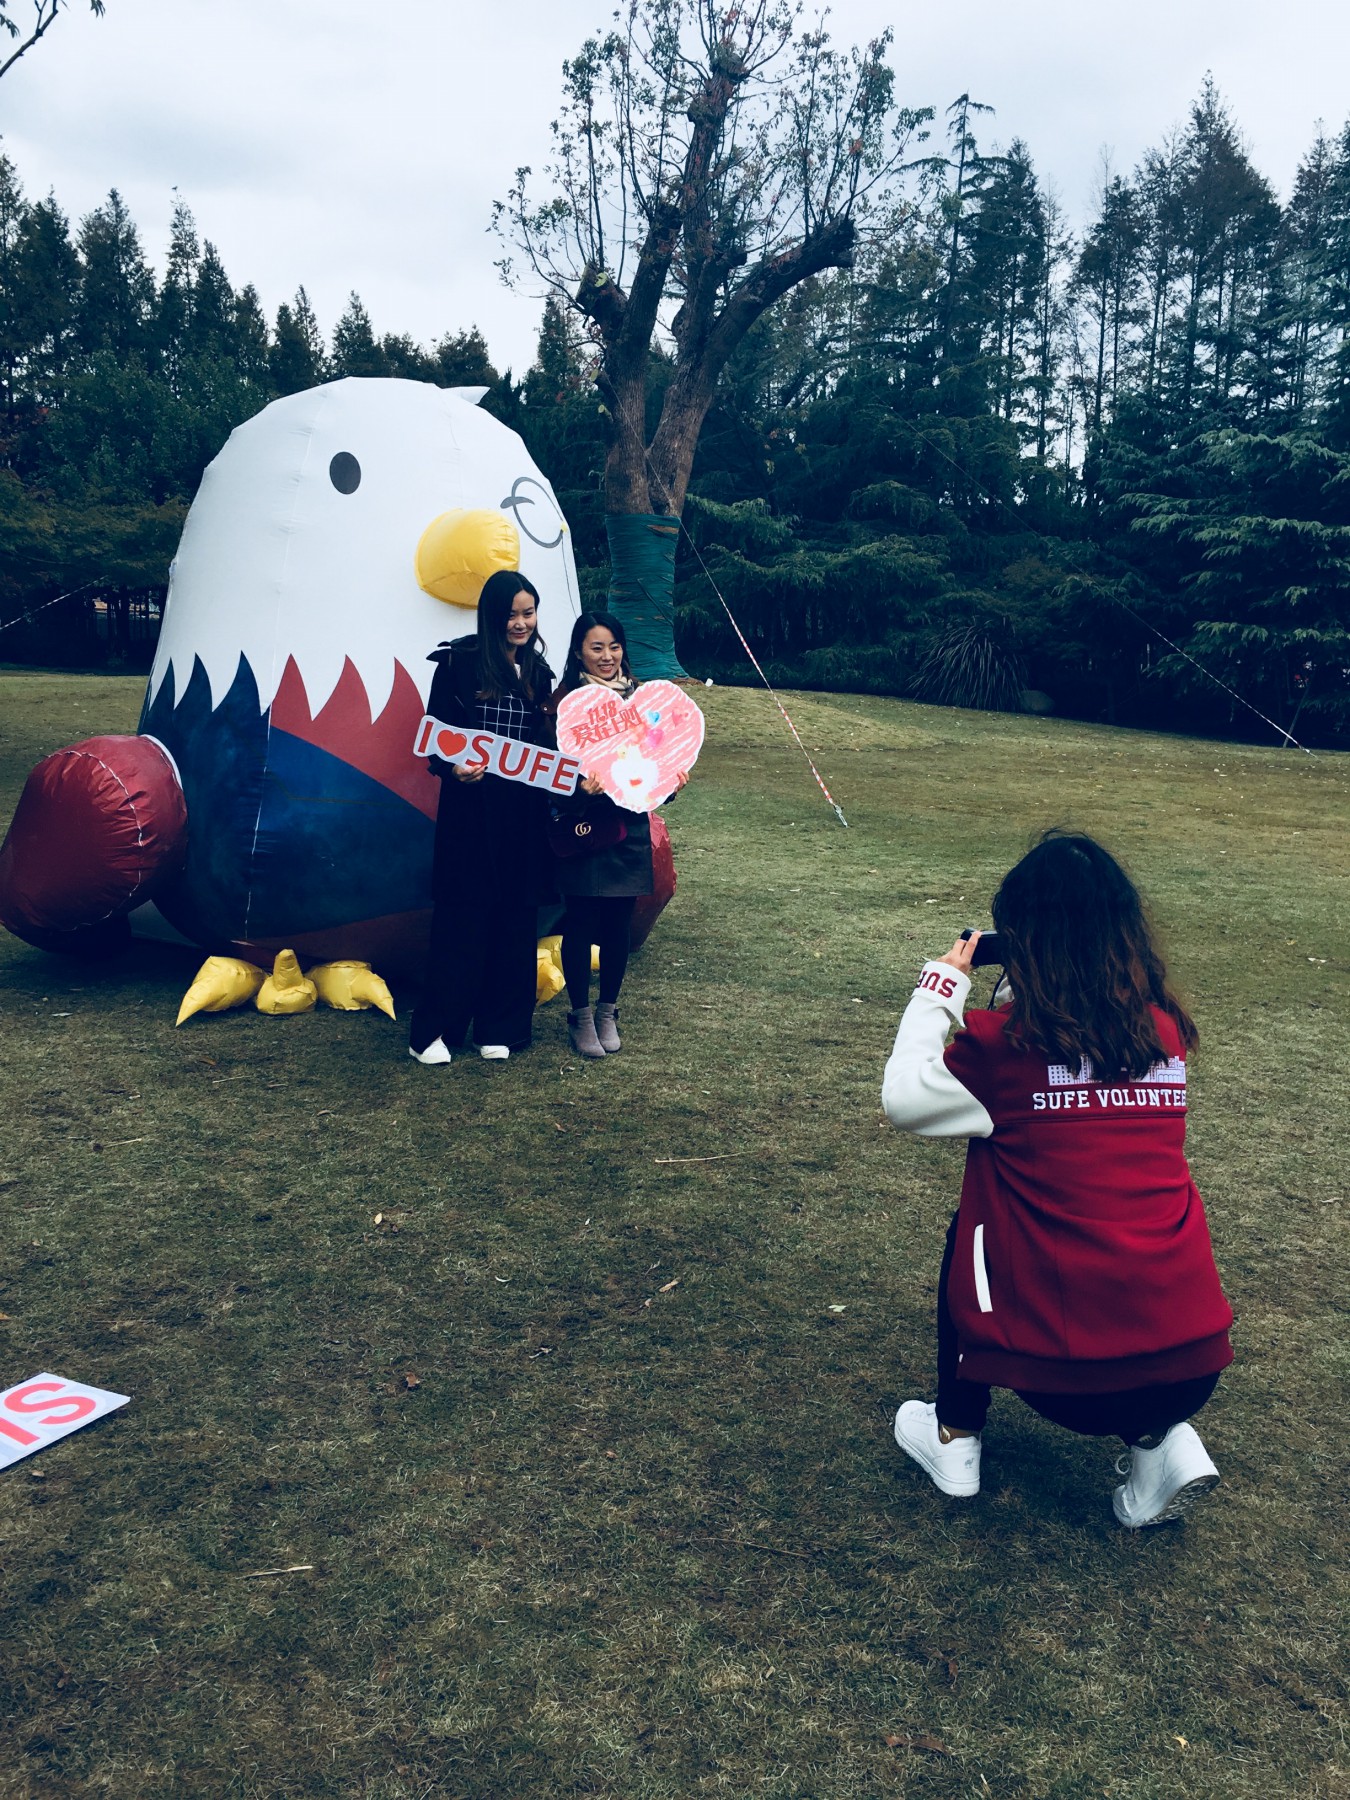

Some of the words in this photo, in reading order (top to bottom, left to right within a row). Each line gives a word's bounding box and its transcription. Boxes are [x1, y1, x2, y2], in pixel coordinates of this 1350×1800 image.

[418, 721, 434, 754] I
[465, 735, 579, 791] SUFE
[1032, 1091, 1090, 1110] SUFE
